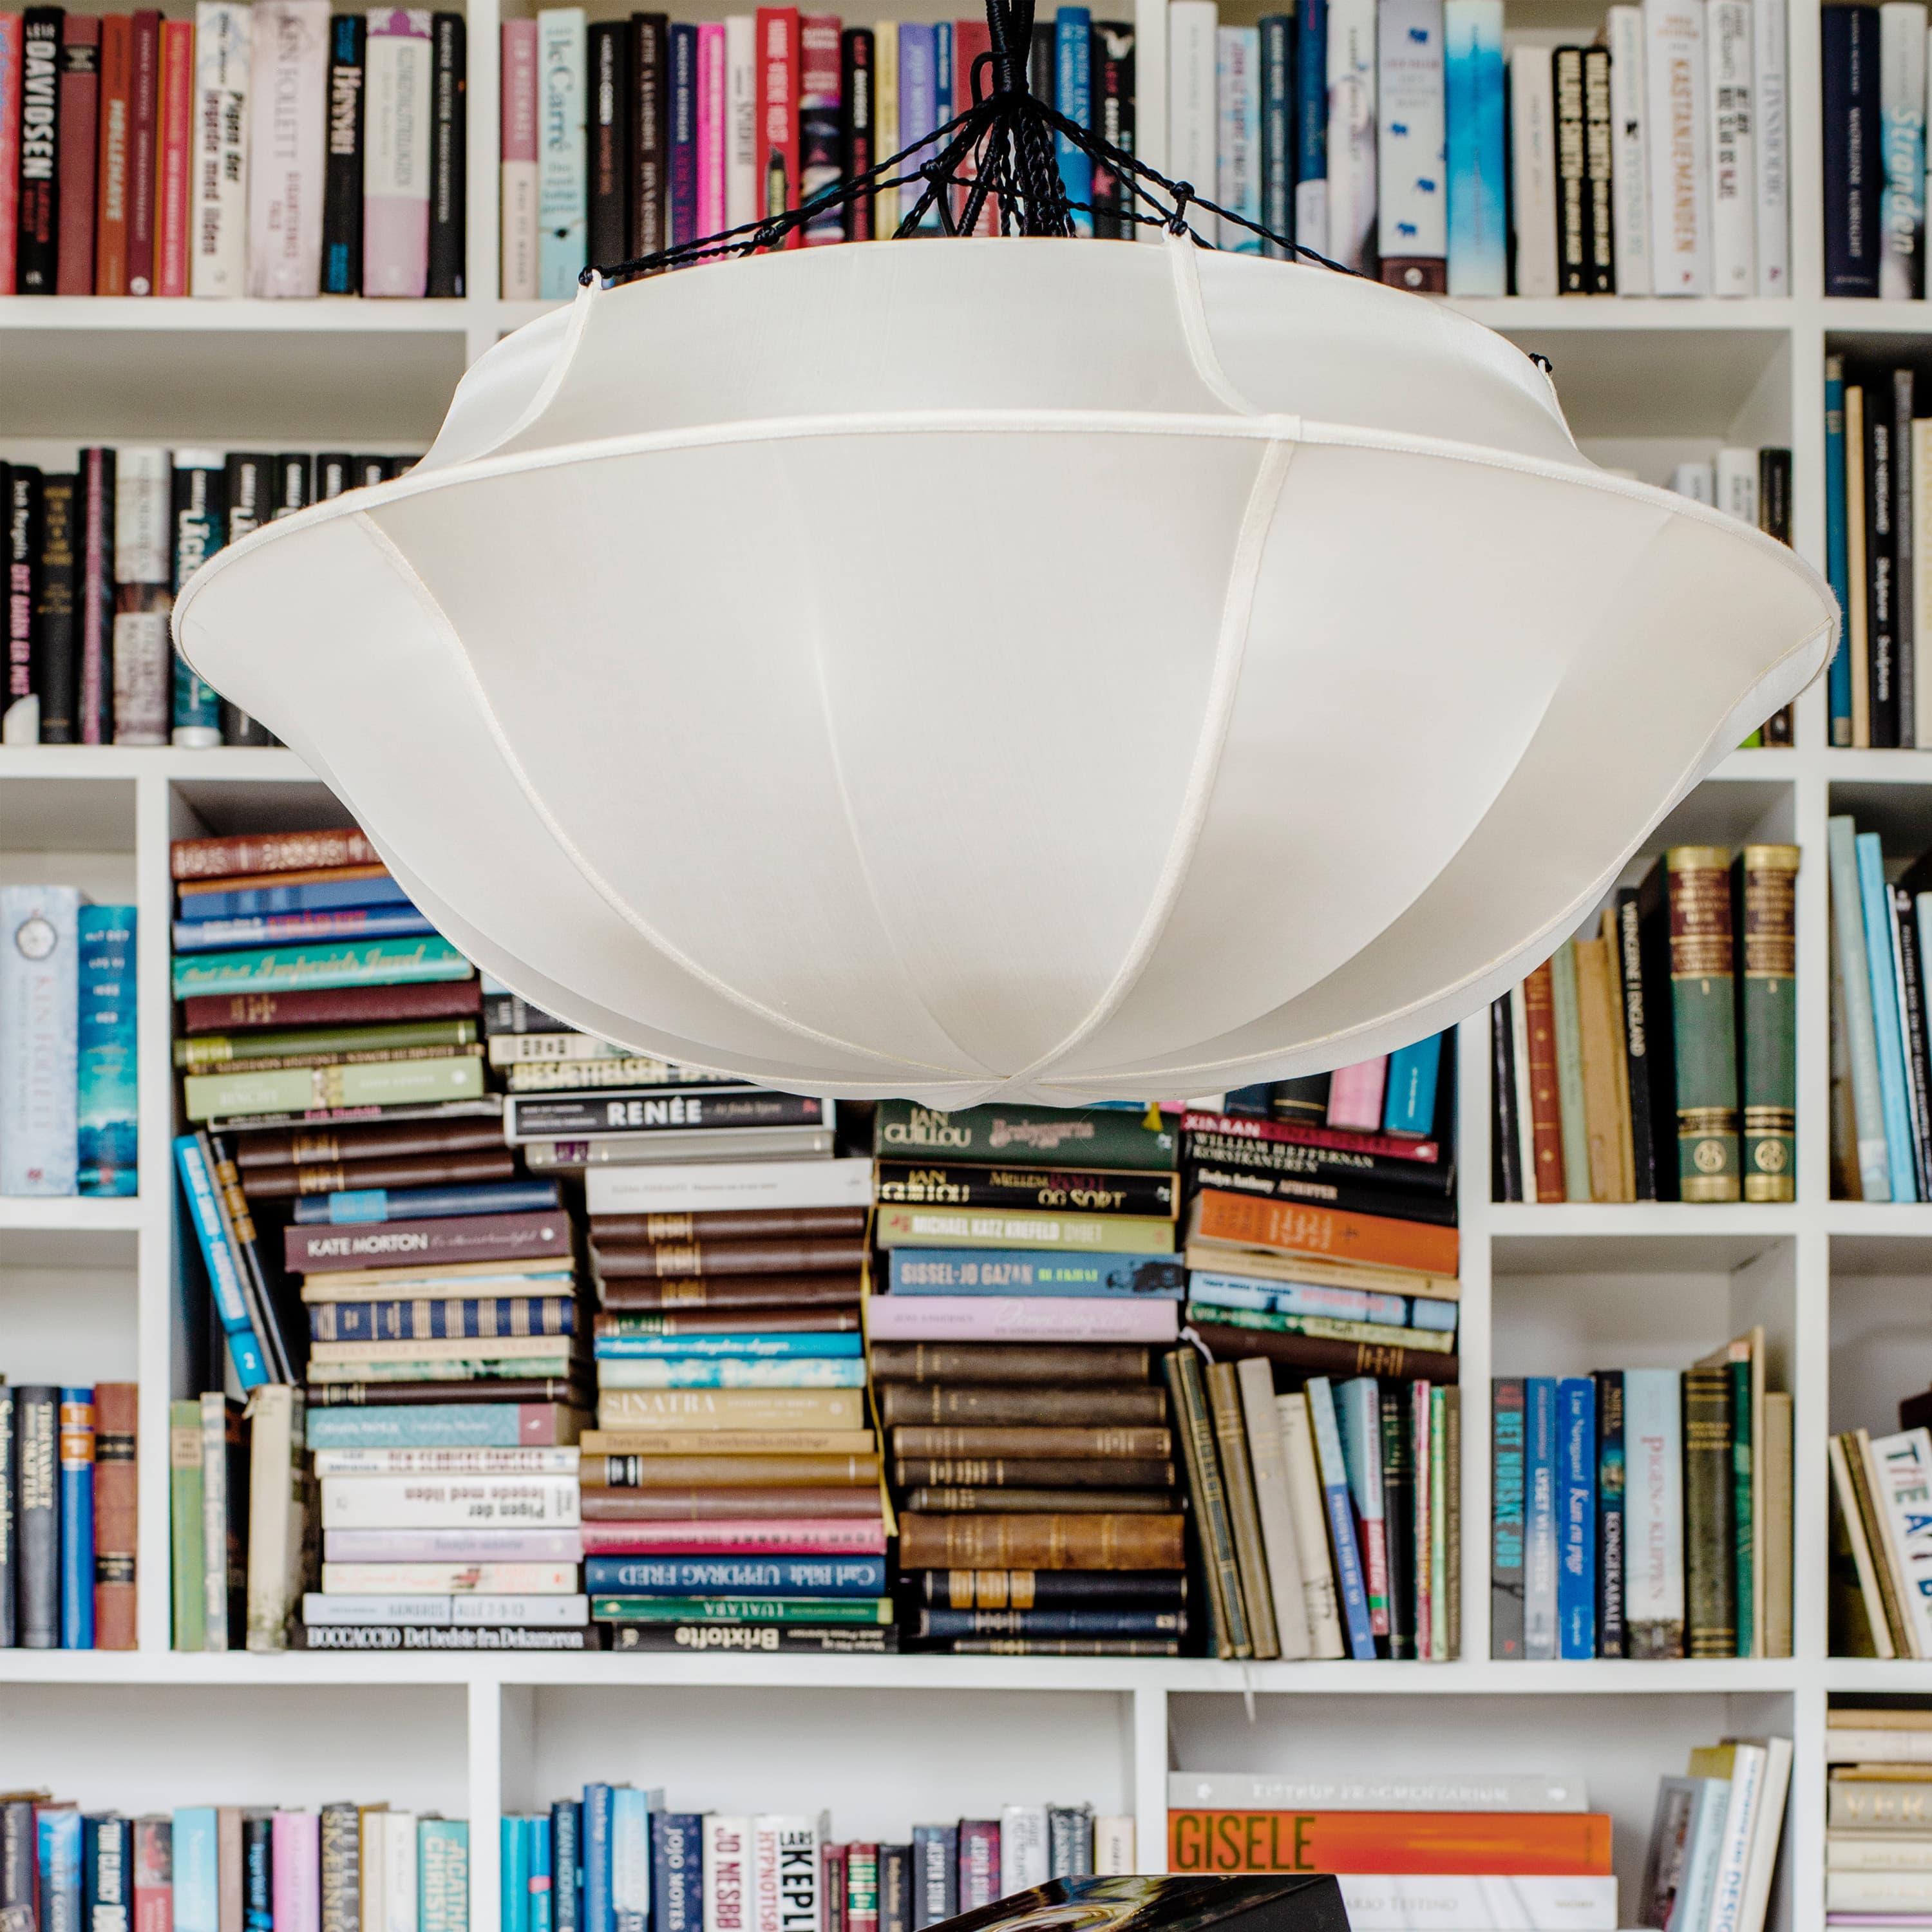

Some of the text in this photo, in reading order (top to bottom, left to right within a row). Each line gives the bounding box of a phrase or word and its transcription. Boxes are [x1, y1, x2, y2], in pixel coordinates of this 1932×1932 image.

[24, 41, 55, 178] DAVIDSEN
[274, 16, 304, 161] KEN FOLLETT
[547, 67, 577, 152] Carré
[1558, 51, 1582, 178] WILBUR SMITH
[1586, 52, 1611, 180] WILBUR SMITH
[227, 91, 244, 182] Pigen der
[1669, 57, 1697, 254] KASTANJEMANDEN
[202, 91, 223, 255] legede med ilden
[1891, 106, 1923, 256] Stranden
[179, 507, 210, 589] LÄCK
[1629, 991, 1647, 1057] ENGLAND
[607, 1096, 703, 1126] RENÉE
[884, 1122, 971, 1148] GUILLOU
[910, 1107, 948, 1127] JAN
[909, 1170, 947, 1186] JAN
[1194, 1133, 1375, 1169] WILLIAM HEFFERNAN
[881, 1181, 971, 1202] GUILLOU
[1037, 1189, 1127, 1208] OG SORT
[308, 1233, 428, 1257] KATE MORTON
[912, 1215, 968, 1236] MICHAEL
[971, 1218, 1004, 1238] KATZ
[1005, 1220, 1061, 1241] KREFELD
[605, 1393, 716, 1415] SINATRA
[405, 1486, 545, 1501] legede med ilden
[469, 1504, 545, 1520] Pigen der
[1535, 1466, 1549, 1510] LYSET
[618, 1564, 876, 1587] Carl Bildt UPPDRAG FRED
[307, 1627, 402, 1649] BOCCACCIO
[404, 1627, 428, 1648] Det
[703, 1602, 784, 1617] LUALABA
[674, 1627, 780, 1650] Brixtofte
[98, 1823, 122, 1903] TOM CLANCY
[1175, 1814, 1316, 1871] GISELE
[424, 1836, 446, 1932] CHRISTI
[663, 1826, 686, 1931] JOJO MOYES
[715, 1827, 743, 1928] JO NESBØ
[759, 1830, 777, 1932] HYPNOTISØ
[781, 1848, 816, 1932] KEPL
[1346, 1897, 1383, 1911] ARIO
[1710, 1870, 1743, 1932] DESIG
